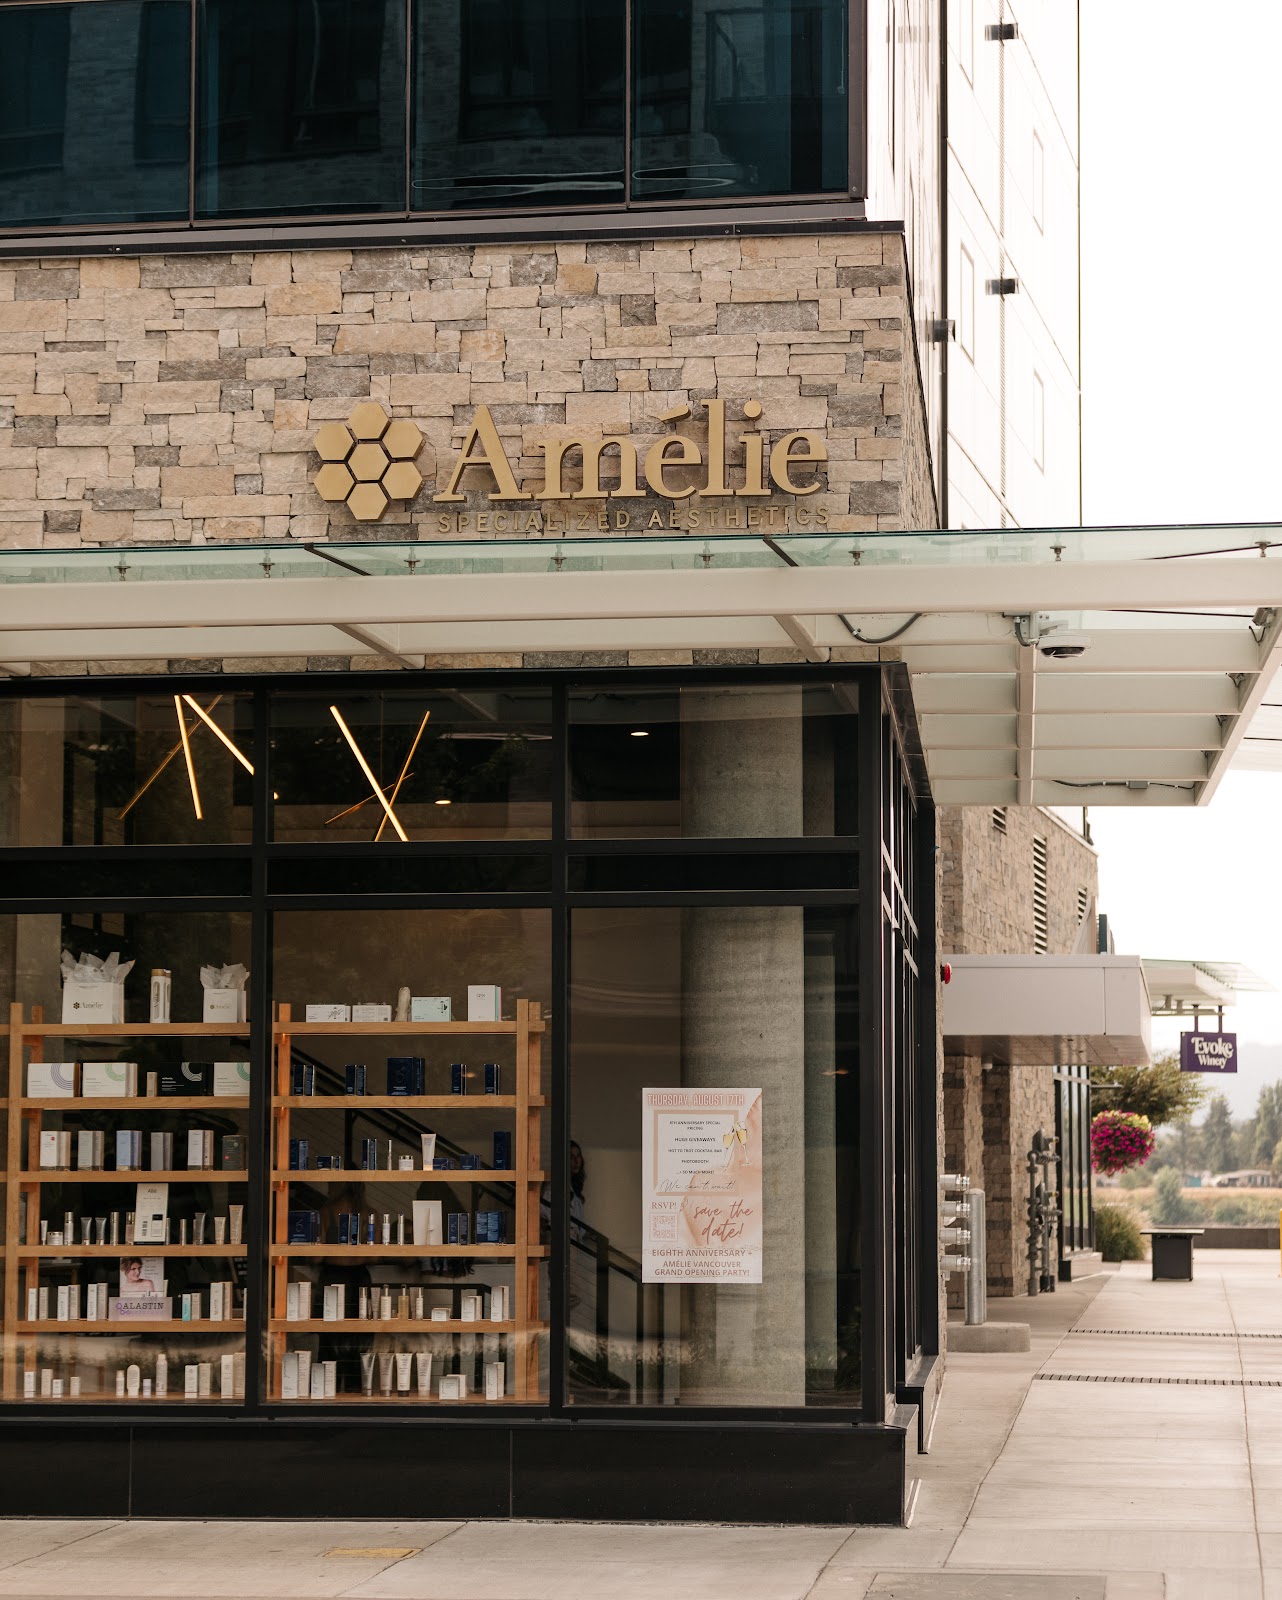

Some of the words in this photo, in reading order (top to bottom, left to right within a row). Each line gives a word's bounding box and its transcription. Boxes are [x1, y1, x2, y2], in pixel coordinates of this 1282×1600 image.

[433, 399, 828, 502] Amélie
[438, 510, 630, 533] SPECIALIZED
[649, 506, 829, 528] AESTHETICS
[1191, 1037, 1234, 1058] Evoke
[1197, 1054, 1228, 1069] Winery
[647, 1094, 691, 1106] THURSDAY,
[693, 1094, 724, 1105] AUGUST
[726, 1094, 745, 1105] 17TH
[659, 1179, 681, 1192] We
[651, 1201, 677, 1210] RSVP!
[693, 1206, 722, 1219] save
[729, 1198, 754, 1219] the
[701, 1216, 744, 1245] date!
[652, 1249, 683, 1257] EIGHTH
[685, 1249, 746, 1257] ANNIVERSARY
[693, 1260, 741, 1268] VANCOUVER
[654, 1268, 683, 1276] GRAND
[684, 1268, 721, 1276] OPENING
[722, 1269, 750, 1277] PARTY!
[122, 1302, 164, 1310] ALASTIN
